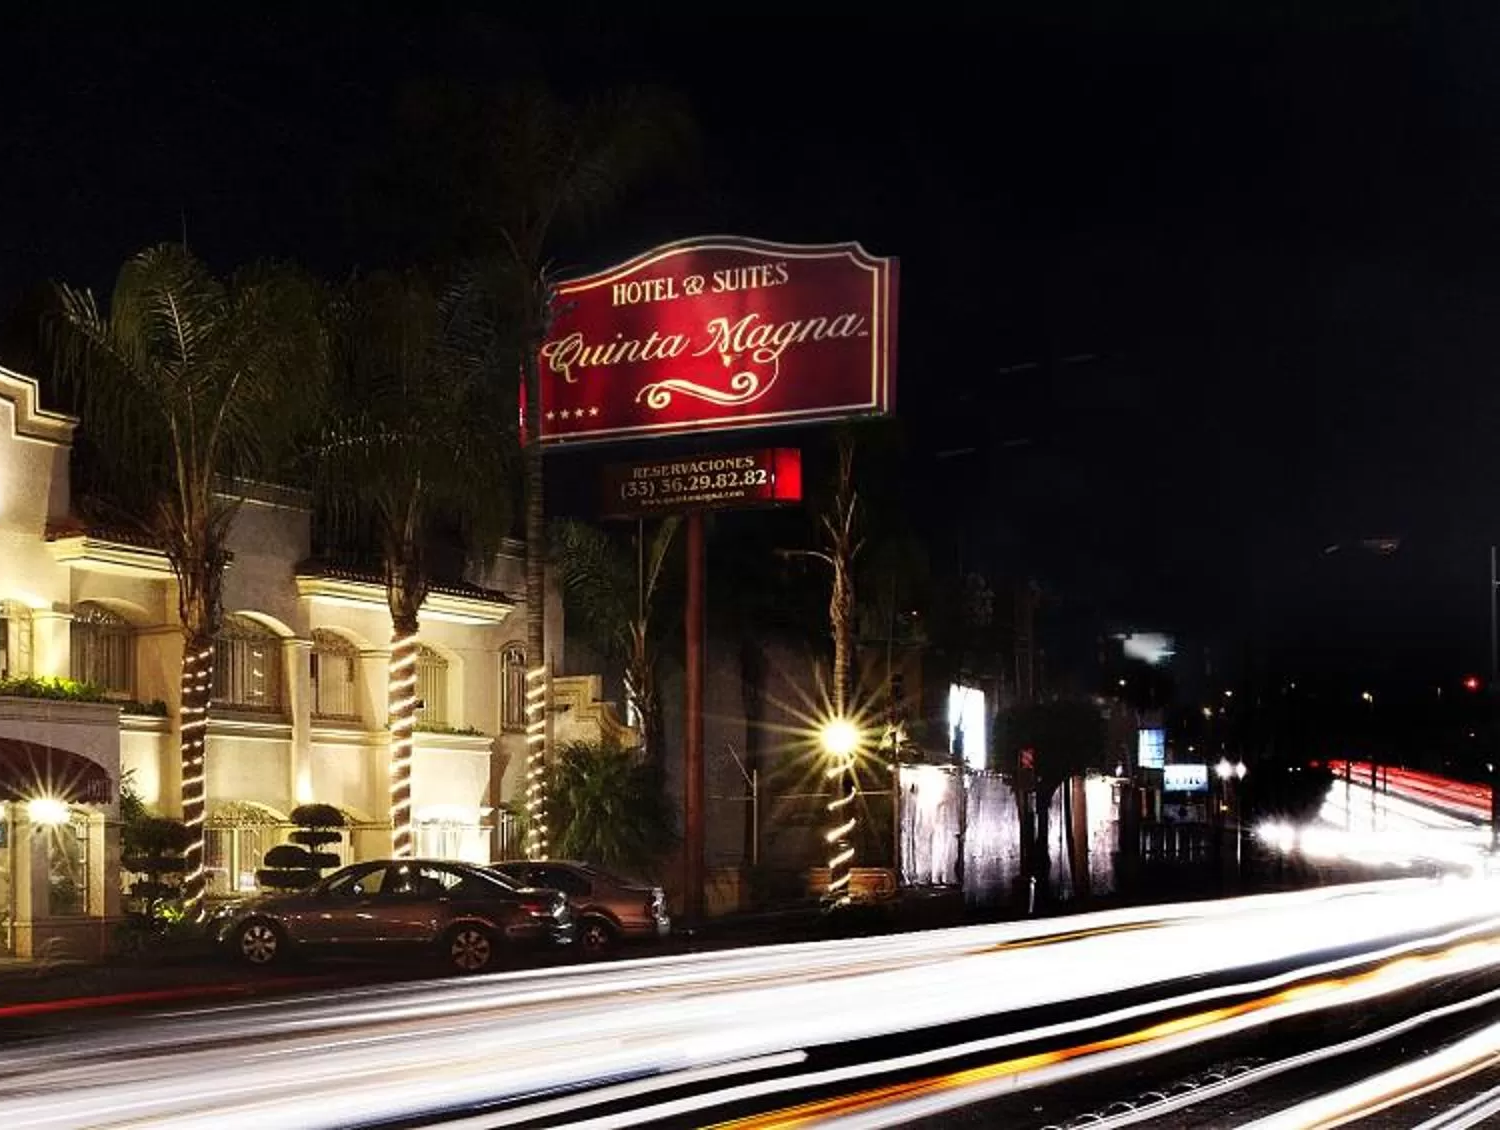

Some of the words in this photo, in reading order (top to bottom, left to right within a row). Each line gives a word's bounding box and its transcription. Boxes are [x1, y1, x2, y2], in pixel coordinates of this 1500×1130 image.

[612, 276, 679, 307] HOTEL
[682, 274, 706, 297] &
[712, 261, 789, 293] SUITES
[541, 332, 690, 383] Quinta
[692, 313, 865, 364] Magna
[632, 455, 755, 481] RESERVACIONES
